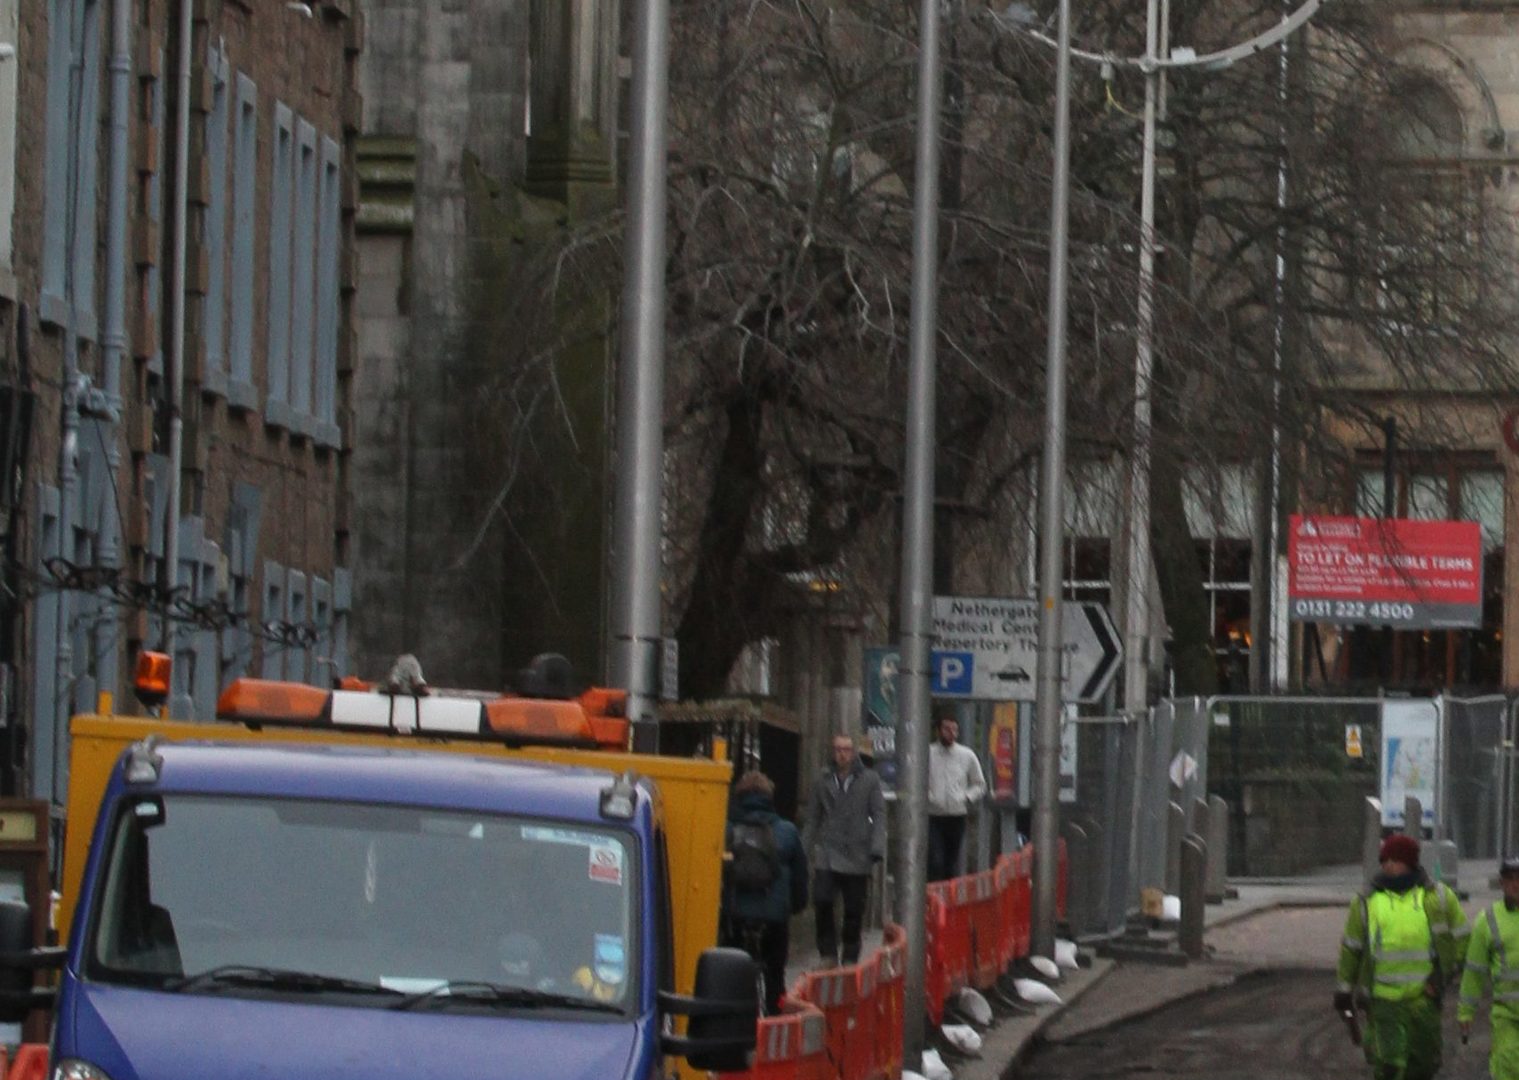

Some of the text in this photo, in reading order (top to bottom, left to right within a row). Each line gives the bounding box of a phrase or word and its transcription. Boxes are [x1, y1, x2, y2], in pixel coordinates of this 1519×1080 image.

[1296, 551, 1315, 565] TO
[1317, 551, 1341, 567] LET
[1344, 552, 1364, 568] ON
[1431, 556, 1473, 571] TERMS
[1296, 600, 1414, 619] 0131 222 4500
[1001, 621, 1038, 635] Cent
[1020, 637, 1080, 652] Thre
[940, 656, 965, 689] P
